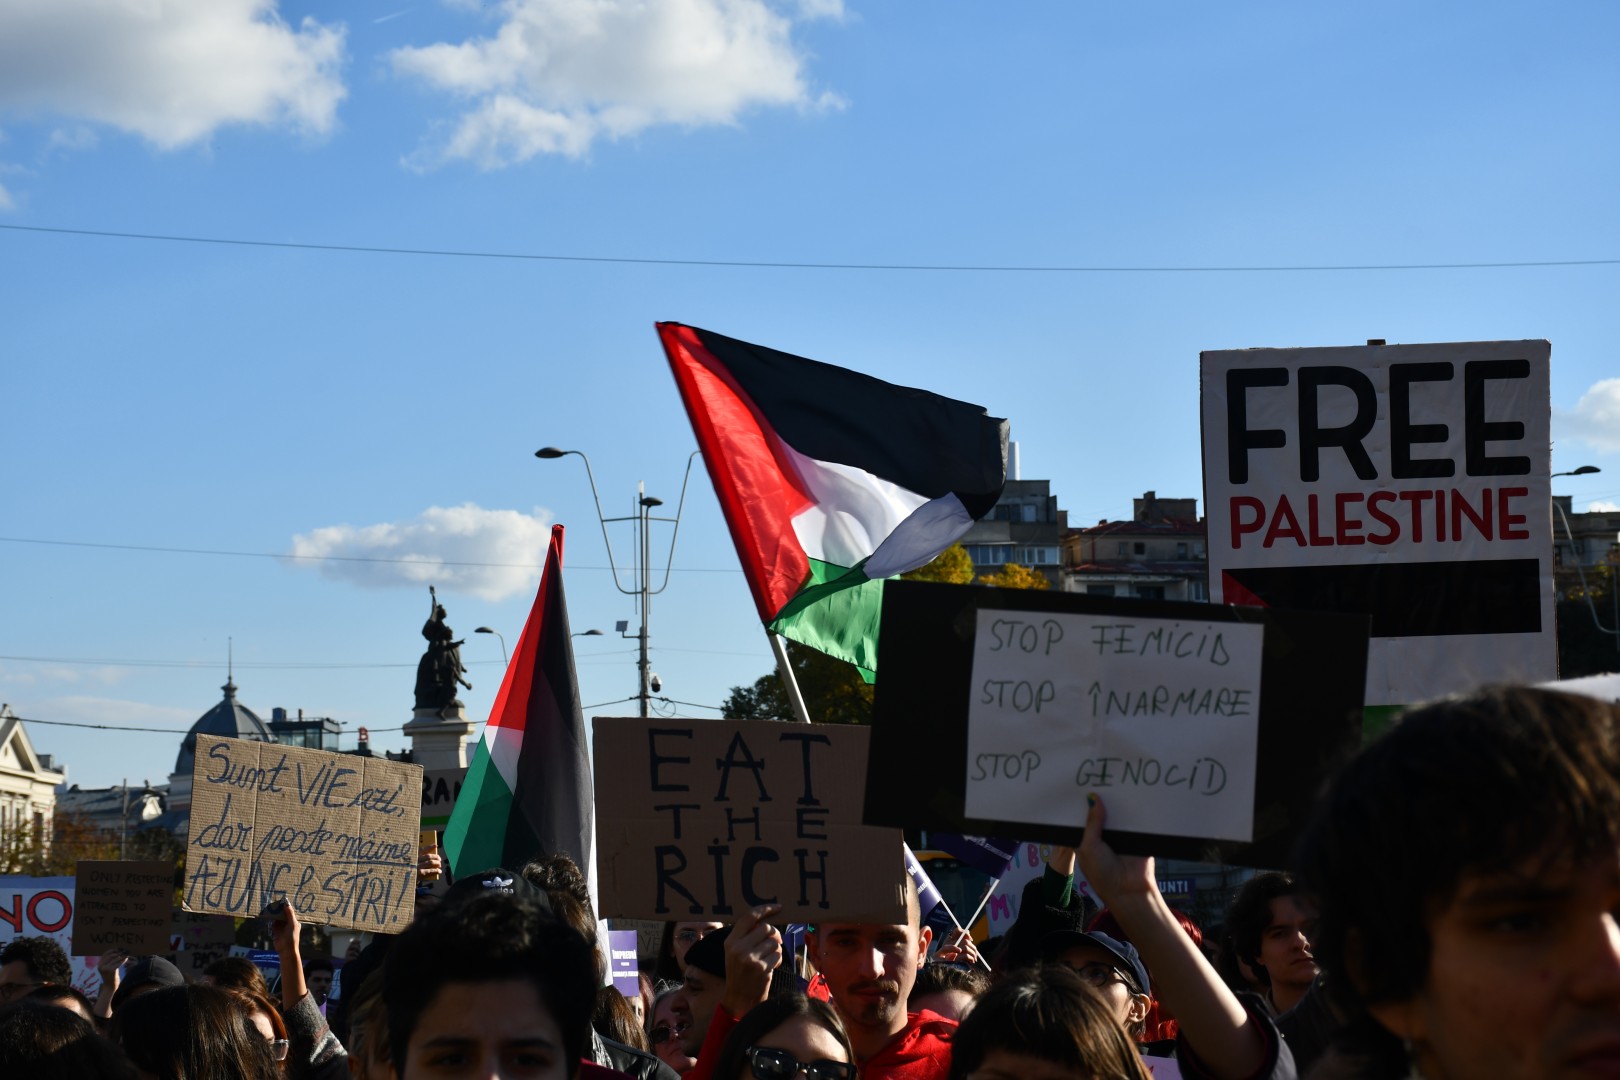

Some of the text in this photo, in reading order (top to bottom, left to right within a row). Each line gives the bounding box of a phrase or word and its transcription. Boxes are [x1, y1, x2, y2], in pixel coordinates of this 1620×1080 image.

[1226, 360, 1531, 484] FREE
[1229, 487, 1530, 549] PALESTINE
[989, 618, 1230, 666] STOP FEMICID
[980, 679, 1253, 718] STOP ÎNARMARE
[206, 742, 290, 793] Sunt
[296, 760, 358, 809] VIE
[648, 728, 831, 806] EAT
[970, 749, 1228, 796] STOP GENOCID
[191, 793, 254, 852] dar
[254, 818, 333, 864] poate
[334, 828, 413, 862] mâine
[653, 803, 830, 842] THE
[81, 887, 120, 897] WOMEN
[147, 888, 165, 898] ARE
[90, 870, 121, 884] ONLY
[186, 853, 292, 915] AJUNG
[293, 865, 317, 914] la
[654, 838, 831, 915] RICH
[79, 901, 146, 912] ATTRACTED TO
[112, 917, 165, 928] RESPECTING
[90, 931, 145, 945] WOMEN
